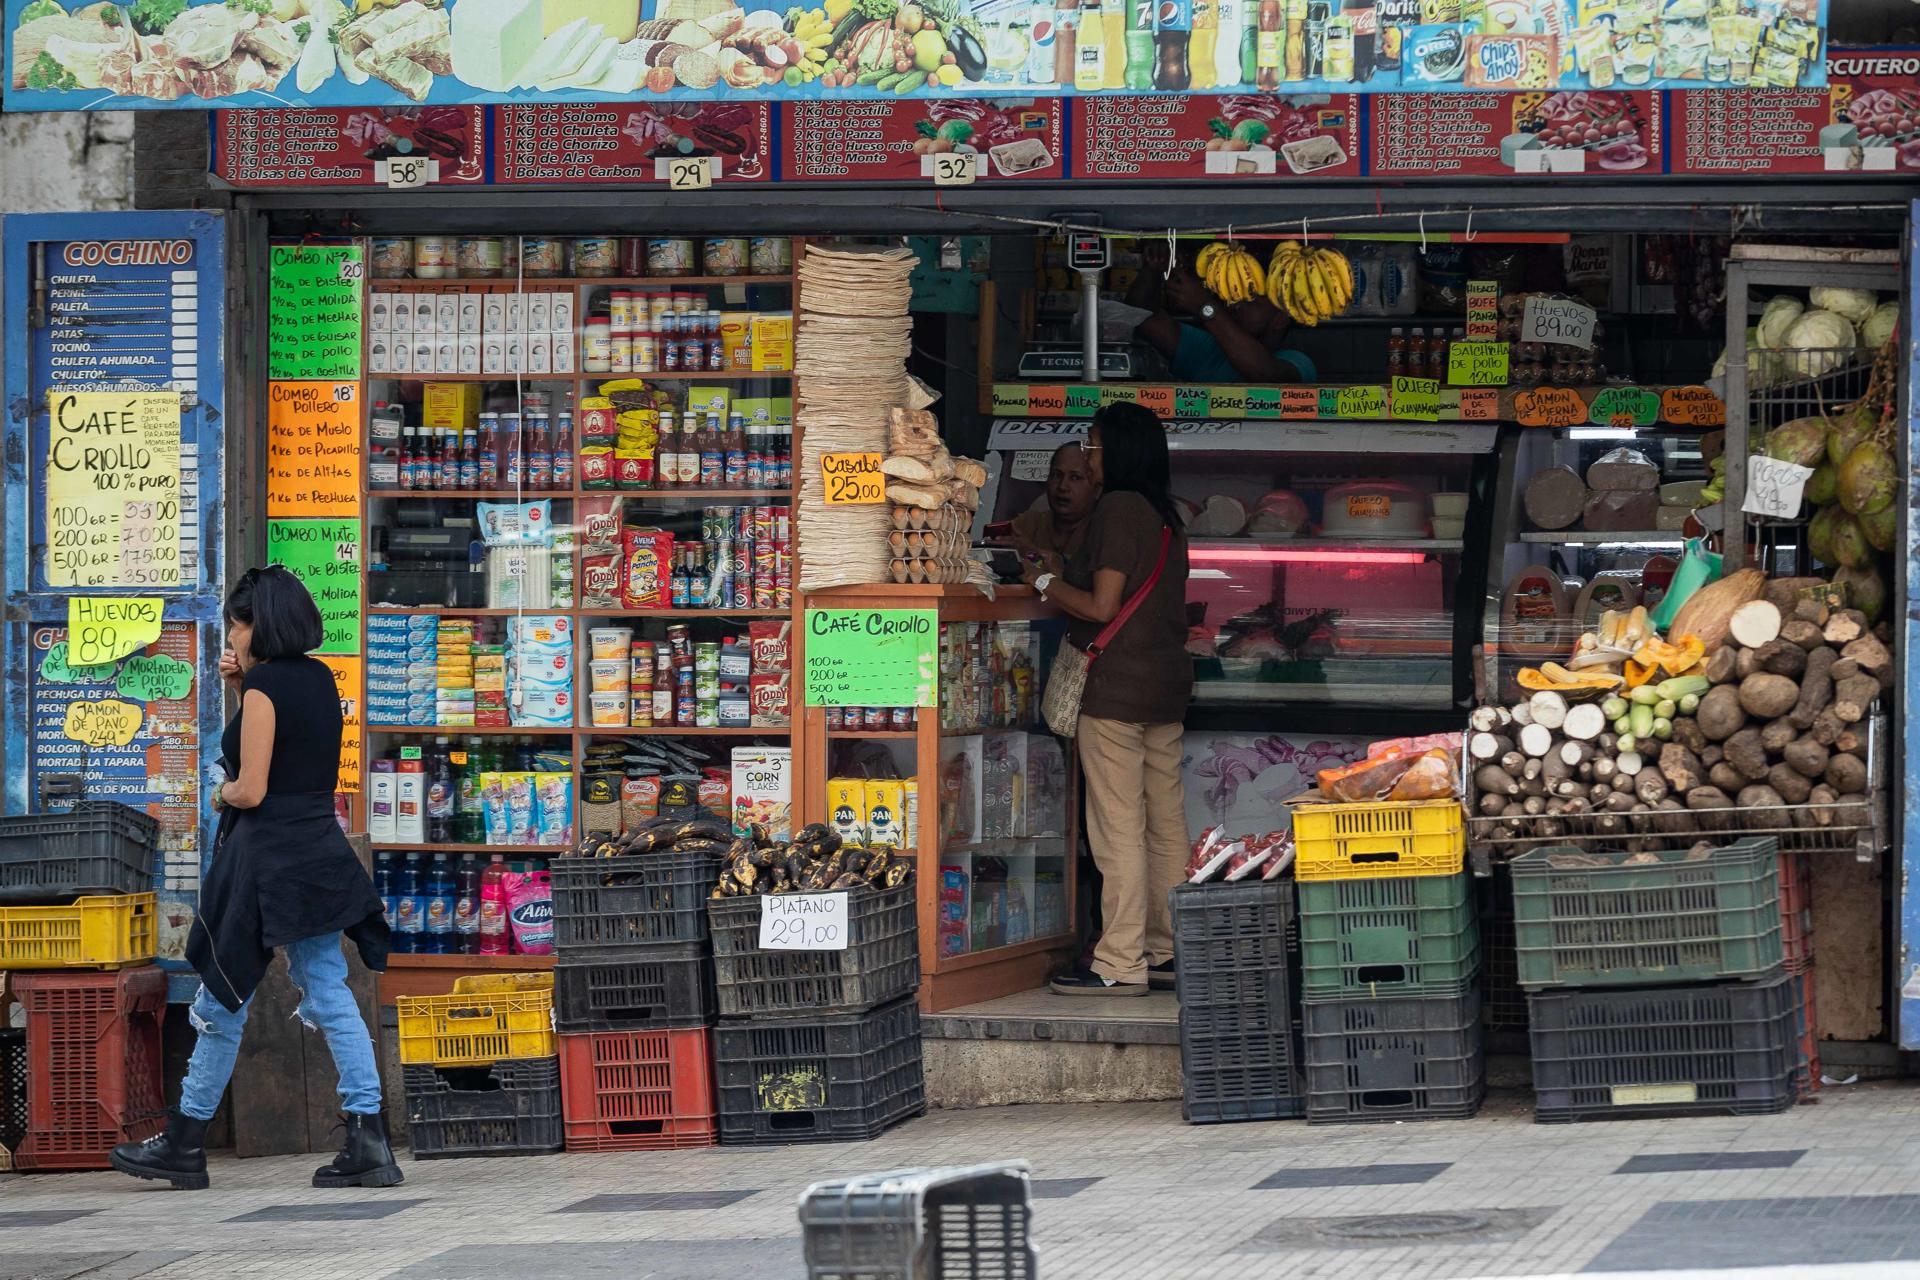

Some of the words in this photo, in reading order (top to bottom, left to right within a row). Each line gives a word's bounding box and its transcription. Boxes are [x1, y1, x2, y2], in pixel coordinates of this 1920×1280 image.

[1480, 41, 1516, 64] Chips
[1086, 104, 1093, 114] 1
[1097, 104, 1115, 116] Kg
[1118, 103, 1135, 113] de
[1138, 103, 1185, 113] Costilla
[227, 114, 236, 125] 2
[240, 114, 258, 127] Kg
[262, 114, 280, 125] de
[284, 114, 337, 125] Solomo
[794, 119, 803, 129] 2
[806, 118, 838, 129] Patas
[842, 118, 858, 128] de
[862, 119, 881, 128] res
[1379, 112, 1386, 121] 1
[1389, 112, 1406, 123] Kg
[1410, 111, 1427, 120] de
[284, 127, 338, 138] Chuleta
[504, 140, 512, 150] 1
[516, 139, 535, 152] Kg
[540, 139, 558, 150] de
[562, 139, 618, 150] Chorizo
[794, 142, 803, 152] 2
[806, 141, 823, 154] Kg
[827, 141, 843, 151] de
[846, 141, 884, 151] Hueso
[887, 141, 914, 154] rojo
[504, 153, 512, 163] 1
[516, 153, 535, 166] Kg
[540, 153, 558, 163] de
[561, 153, 593, 163] Alas
[1377, 160, 1387, 169] 2
[1436, 160, 1461, 171] pan
[227, 169, 236, 179] 2
[240, 168, 284, 179] Bolsas
[289, 168, 305, 179] de
[309, 167, 361, 179] Carbon
[796, 165, 803, 175] 1
[806, 165, 848, 175] Cubito
[64, 240, 193, 266] COCHINO
[274, 248, 320, 265] COMBO
[299, 279, 311, 287] DE
[302, 316, 315, 325] DE
[318, 313, 358, 323] MECHAR
[1531, 301, 1588, 325] HUEVOS
[51, 357, 97, 366] CHULETA
[1451, 359, 1466, 369] DE
[273, 385, 318, 401] COMBO
[1397, 378, 1439, 395] QUESO
[1526, 394, 1571, 410] JAMON
[1602, 392, 1641, 406] JAMON
[58, 395, 138, 435] CAFÉ
[1465, 409, 1487, 418] RES
[1520, 410, 1533, 419] DE
[1539, 405, 1578, 416] PIERNA
[1593, 407, 1605, 417] DE
[1616, 402, 1648, 415] PAVO
[1667, 408, 1681, 416] DE
[299, 427, 312, 436] DE
[53, 436, 151, 472] CRIOLLO
[823, 455, 880, 474] Casabe
[139, 475, 175, 491] PURO
[297, 493, 308, 502] DE
[312, 490, 357, 503] PECHUGA
[53, 506, 87, 526] 100
[271, 524, 317, 543] COMBO
[54, 549, 88, 569] 500
[309, 564, 321, 576] DE
[78, 599, 156, 622] HUEVOS
[370, 618, 406, 627] Alident
[812, 611, 861, 635] CAFÉ
[755, 640, 787, 655] TODDY
[810, 669, 834, 680] 200
[119, 676, 136, 688] DE
[37, 690, 88, 699] PECHUGA
[90, 690, 103, 699] DE
[77, 703, 120, 720] JAMON
[370, 712, 406, 721] Alident
[72, 719, 88, 731] DE
[96, 716, 128, 730] PAVO
[90, 730, 116, 744] 249
[746, 773, 779, 781] CORN
[747, 782, 779, 791] FLAKES
[834, 811, 856, 821] PAN
[870, 811, 892, 821] PAN
[770, 896, 835, 914] PLATANO
